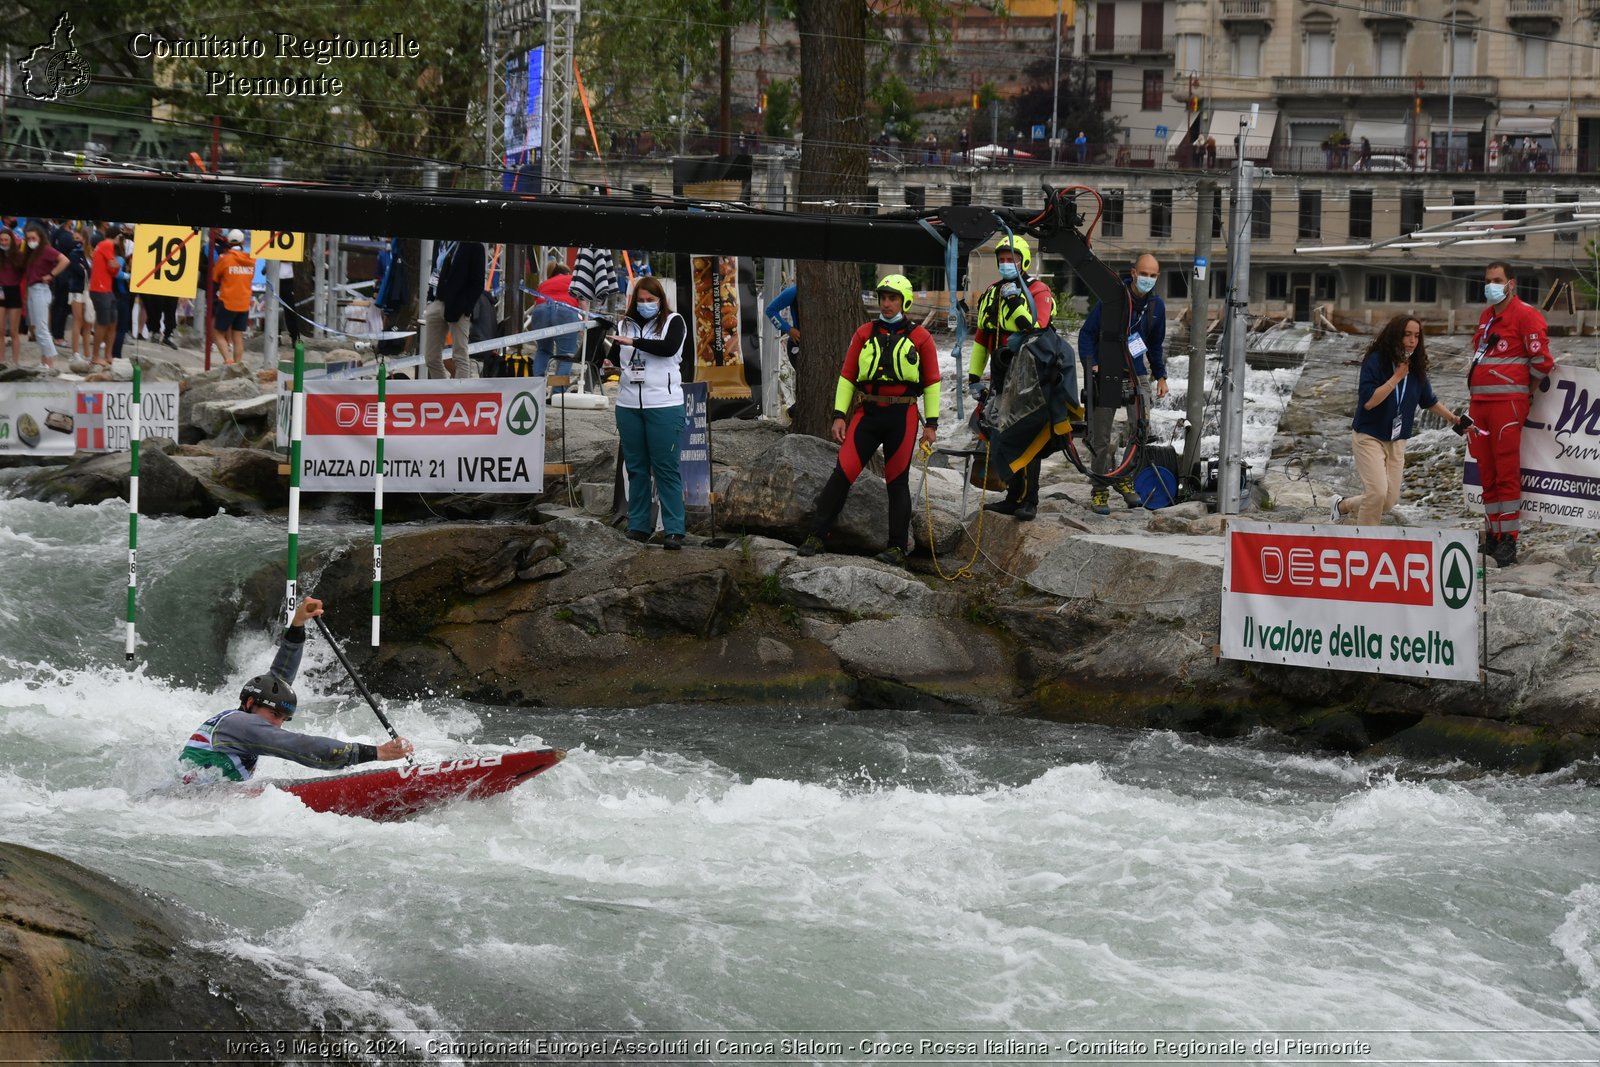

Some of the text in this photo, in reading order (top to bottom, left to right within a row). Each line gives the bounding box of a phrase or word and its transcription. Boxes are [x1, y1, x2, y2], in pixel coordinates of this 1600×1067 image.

[148, 235, 187, 282] 19
[335, 401, 499, 428] DESPAR
[304, 459, 356, 478] PIAZZA
[429, 459, 446, 478] 21
[457, 457, 530, 483] IVREA
[1468, 492, 1484, 505] GLO
[1520, 500, 1538, 512] VICE
[1539, 501, 1584, 518] PROVIDER
[1260, 546, 1430, 593] DESPAR
[1243, 616, 1455, 666] Il valore della scelta
